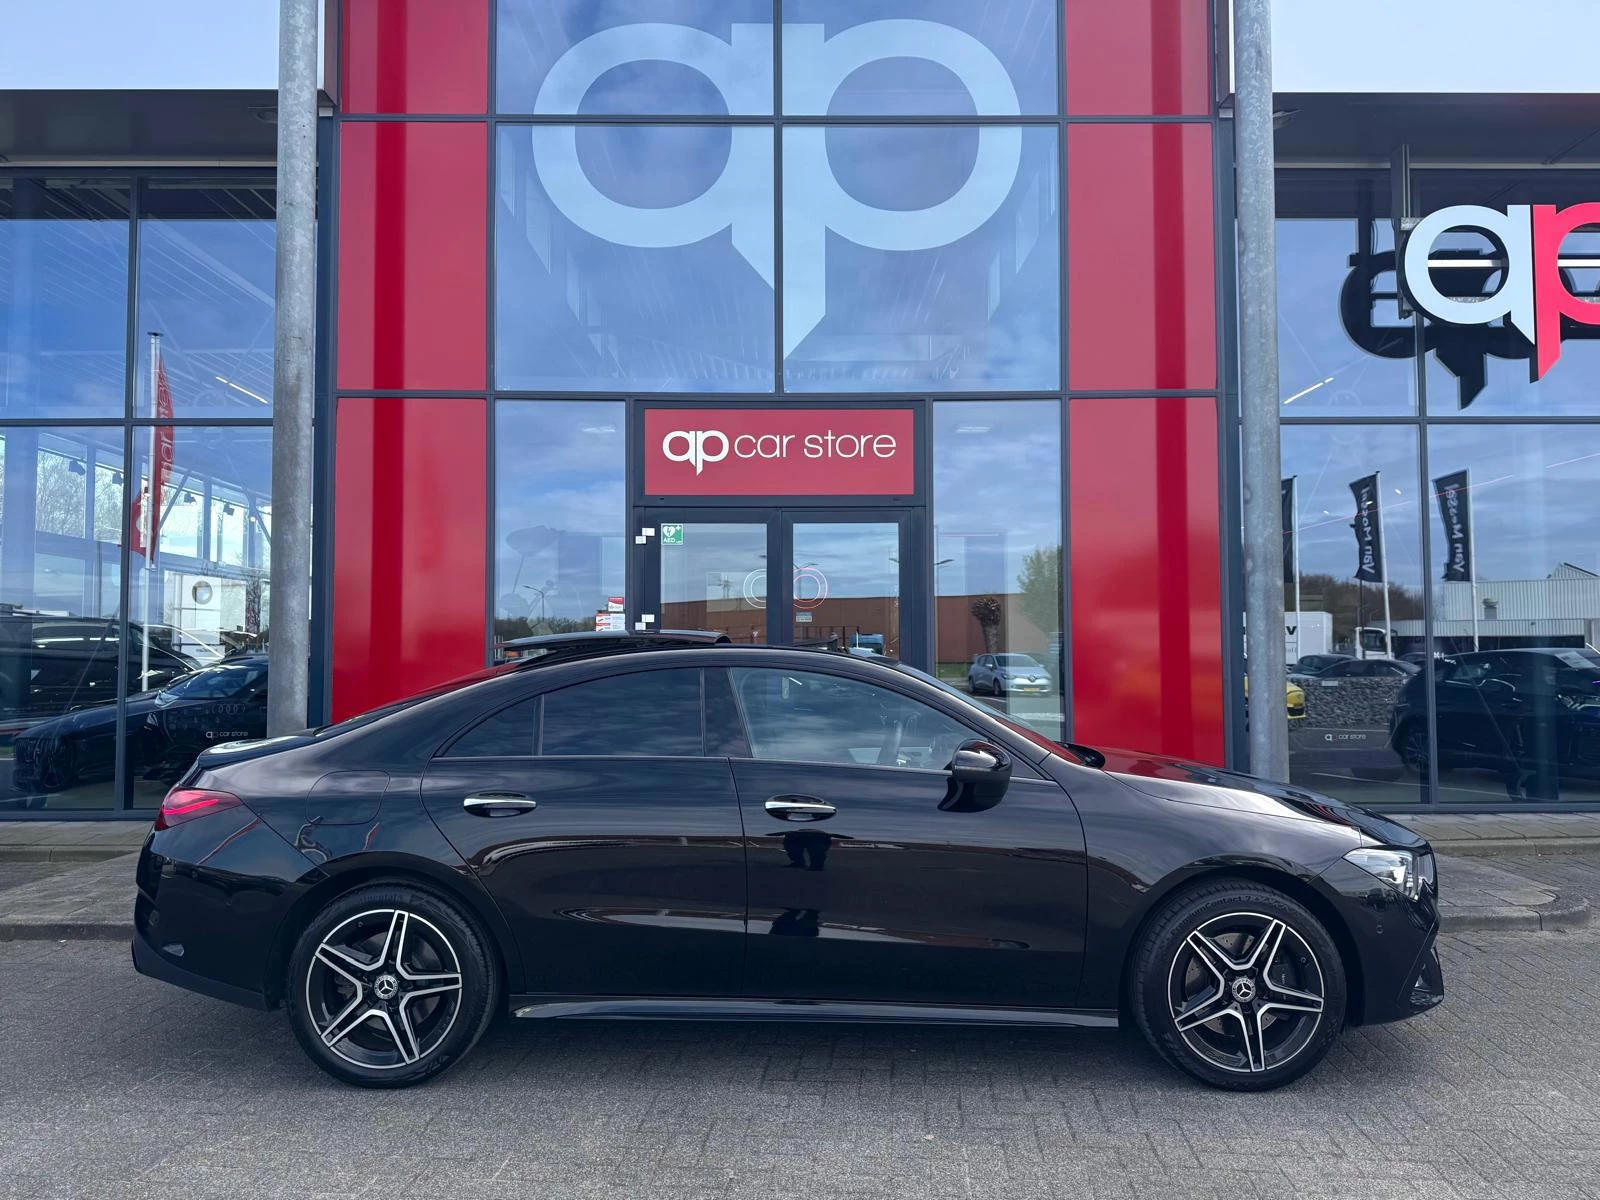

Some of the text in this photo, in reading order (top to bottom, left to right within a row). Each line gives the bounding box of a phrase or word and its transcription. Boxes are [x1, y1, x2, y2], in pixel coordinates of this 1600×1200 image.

[662, 430, 897, 476] ap car store
